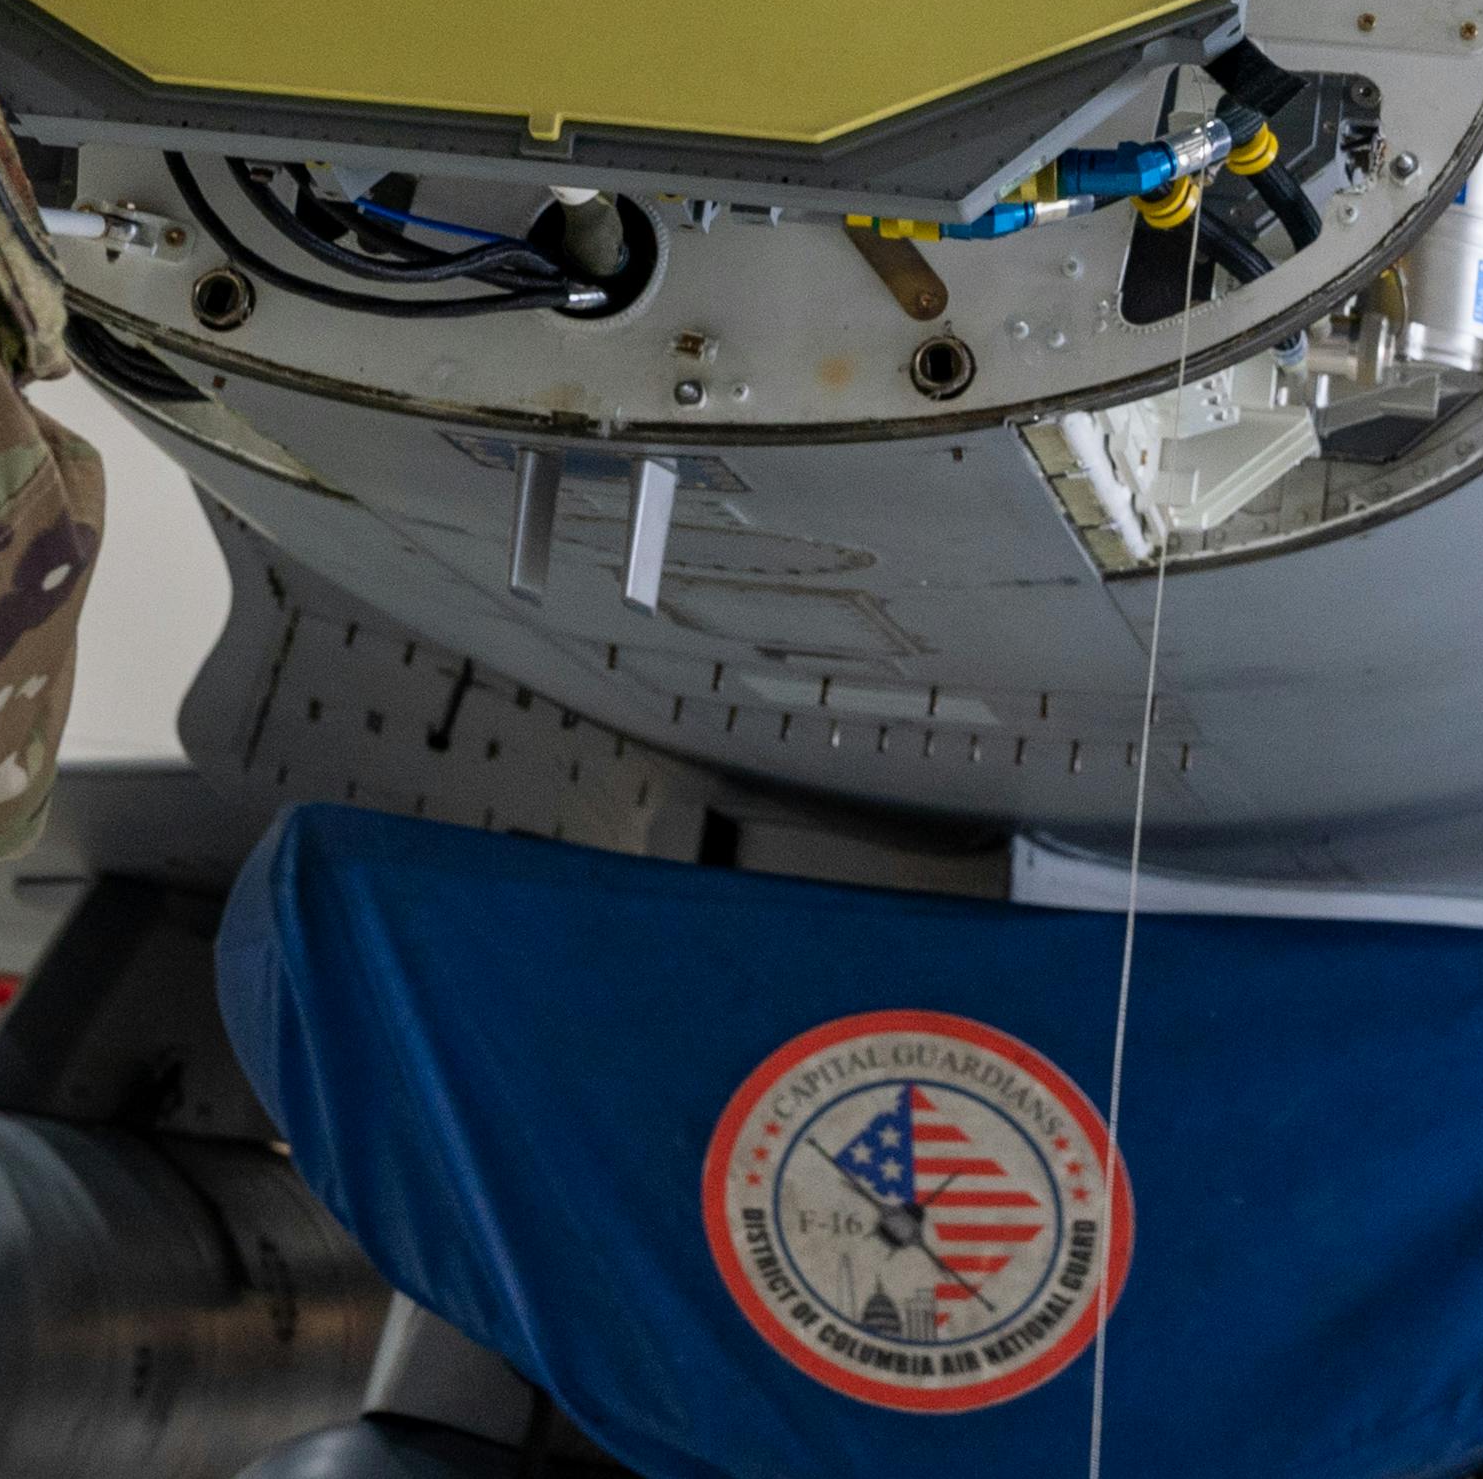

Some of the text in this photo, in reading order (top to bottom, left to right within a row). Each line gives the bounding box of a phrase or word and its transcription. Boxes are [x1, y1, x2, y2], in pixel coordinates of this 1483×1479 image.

[773, 1042, 1065, 1136] CAPITAL GUARDIANS
[798, 1209, 863, 1235] F-16
[742, 1207, 1096, 1377] DISTRICT OF COLUMBIA AIR NATIONAL GUARD
